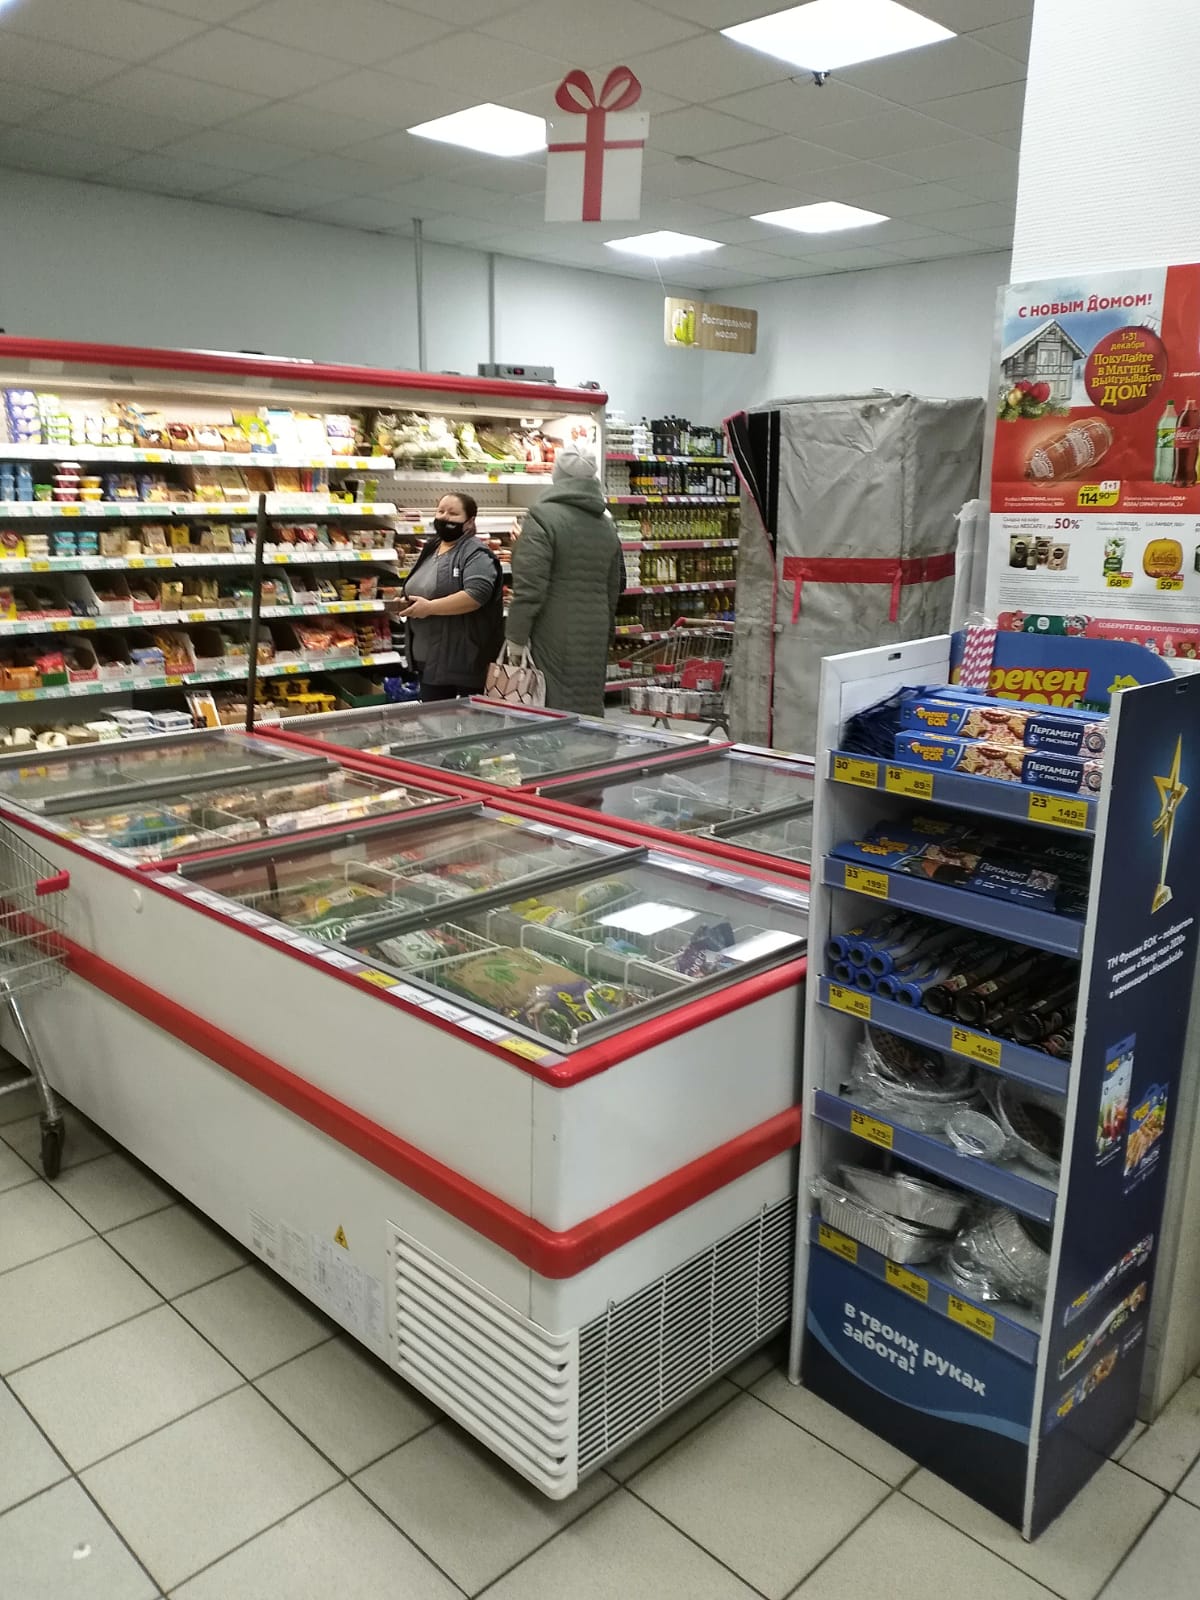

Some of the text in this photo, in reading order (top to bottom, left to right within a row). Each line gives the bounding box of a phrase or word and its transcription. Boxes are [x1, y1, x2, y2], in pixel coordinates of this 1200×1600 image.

[1018, 293, 1153, 318] С НОВЫМ ДОМОМ!
[1110, 341, 1146, 351] декабря
[1080, 492, 1098, 504] 114
[842, 1321, 916, 1376] забота!
[859, 1310, 919, 1357] твоих
[923, 1348, 986, 1397] руках
